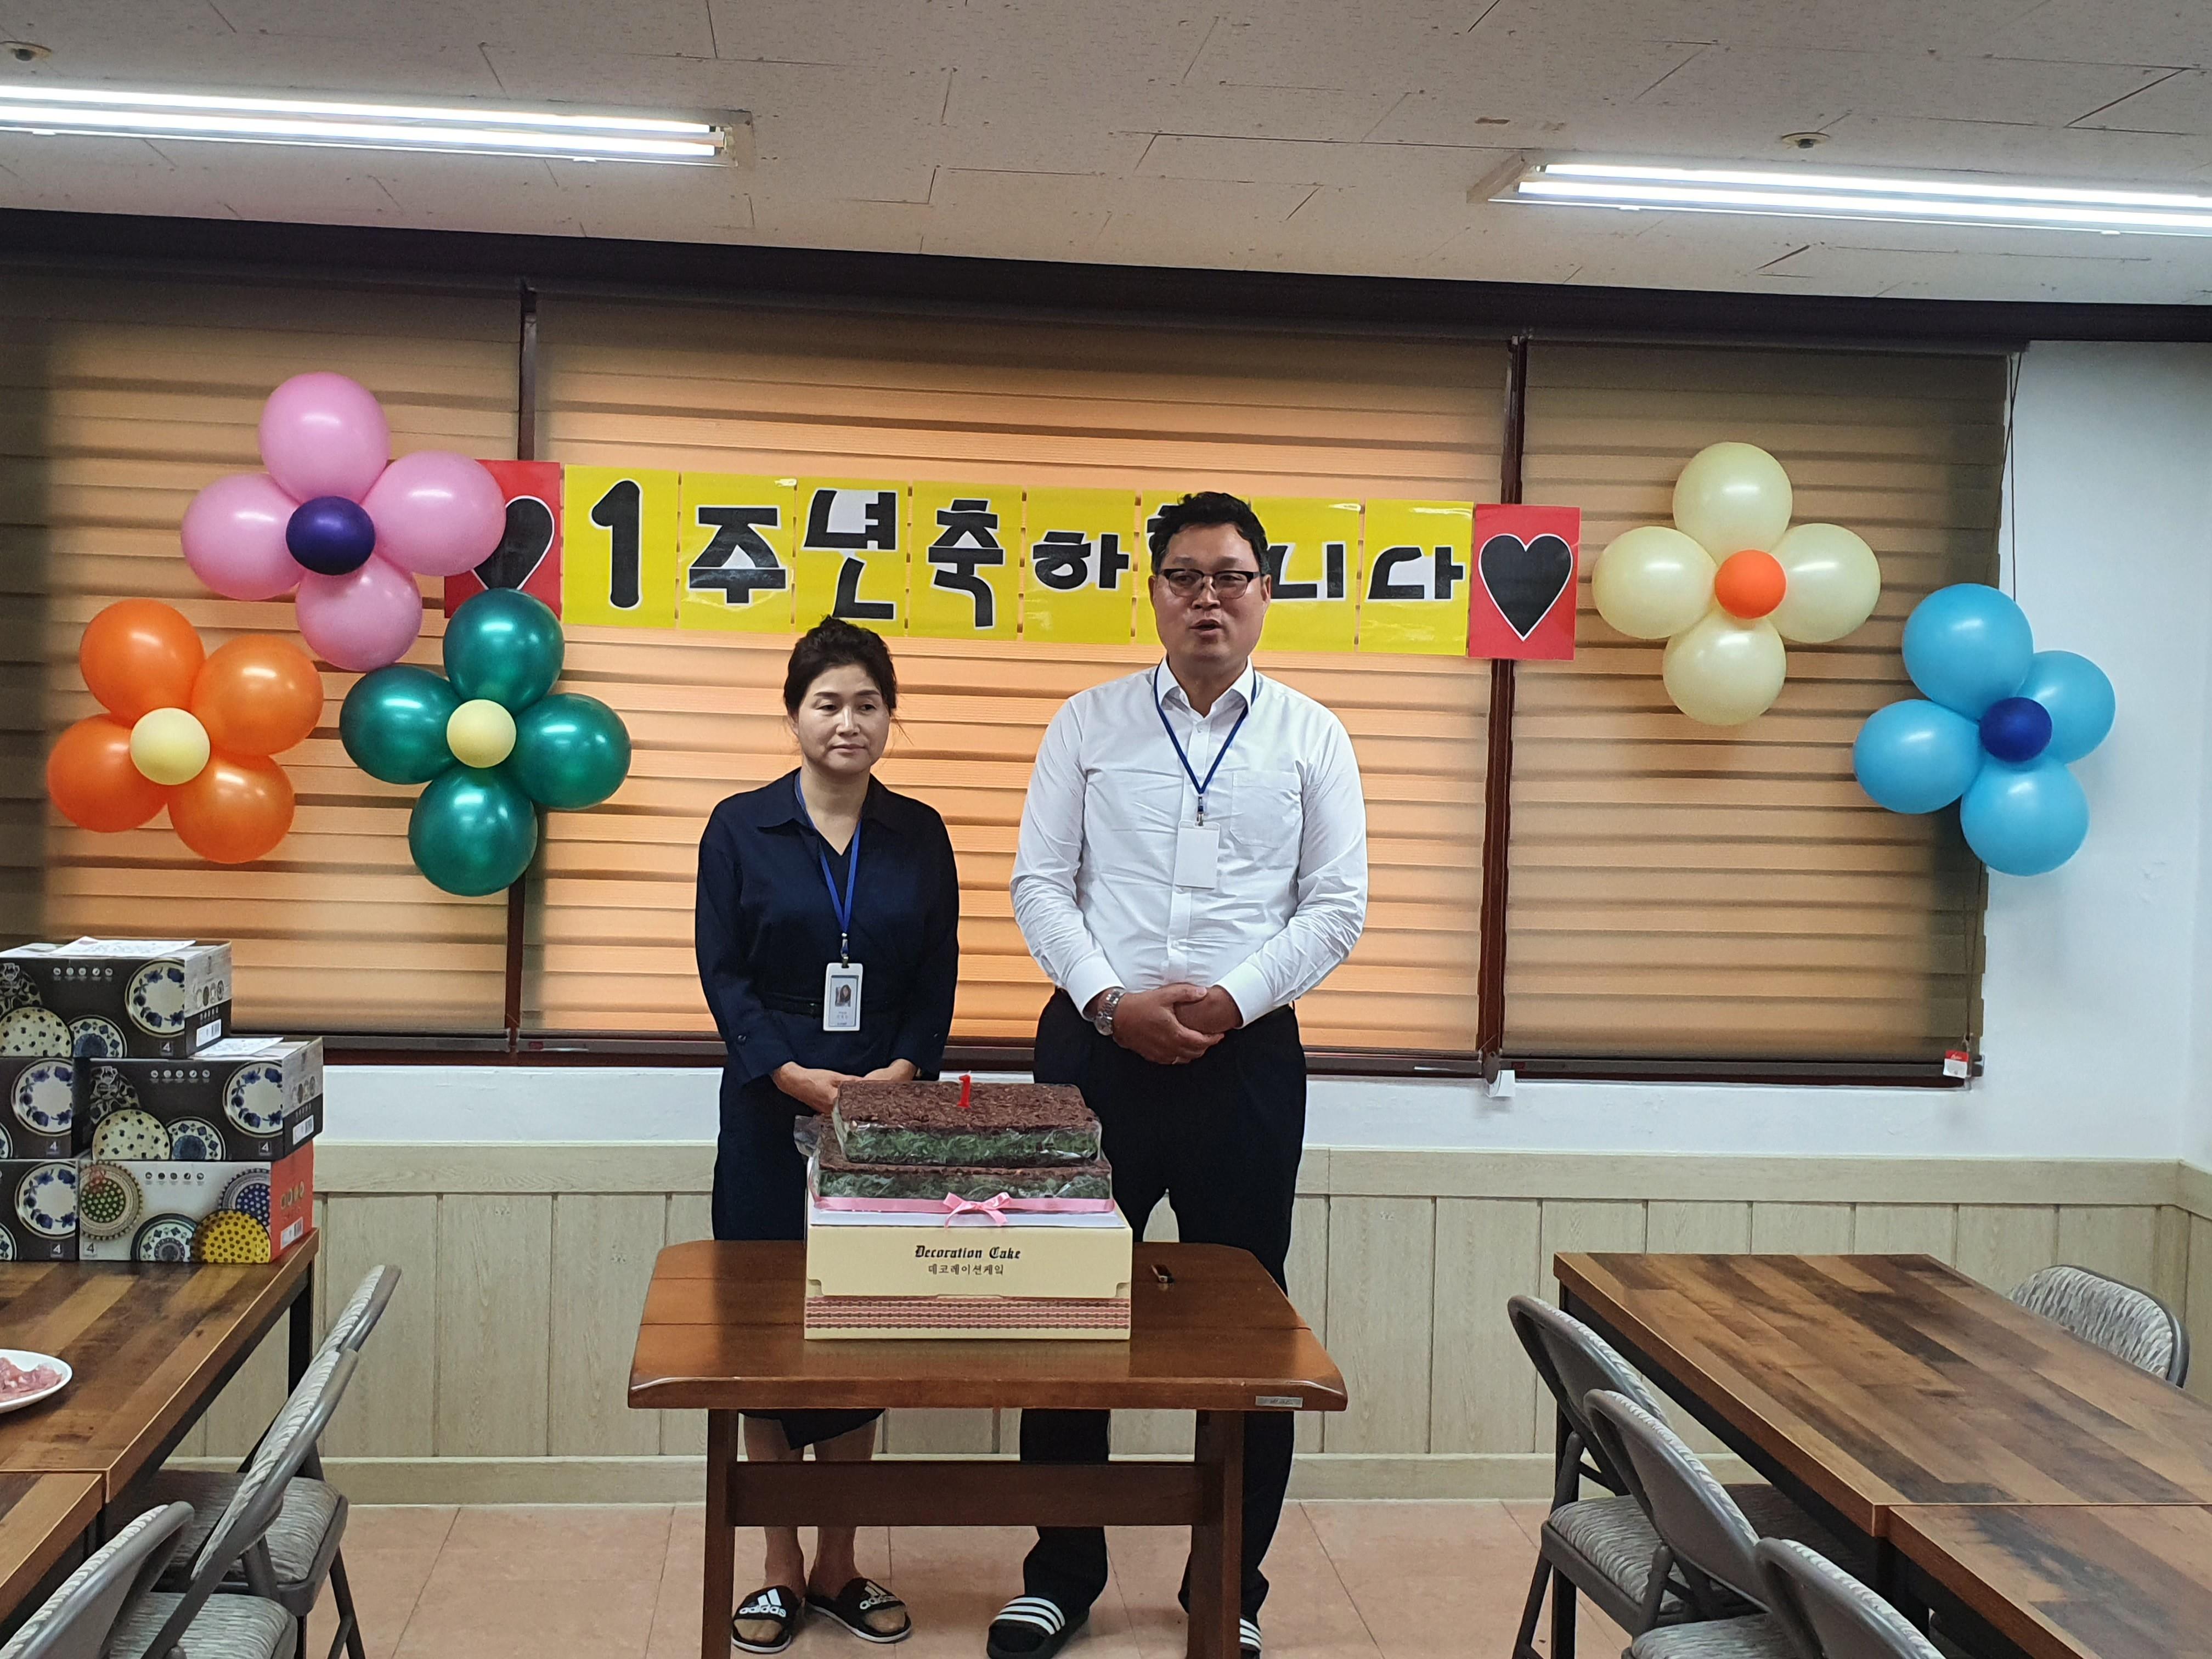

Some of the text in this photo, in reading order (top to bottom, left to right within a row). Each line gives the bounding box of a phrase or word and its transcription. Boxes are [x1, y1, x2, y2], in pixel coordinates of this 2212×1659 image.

[915, 1245, 1022, 1260] Decoration Cake
[739, 1604, 787, 1618] adidas
